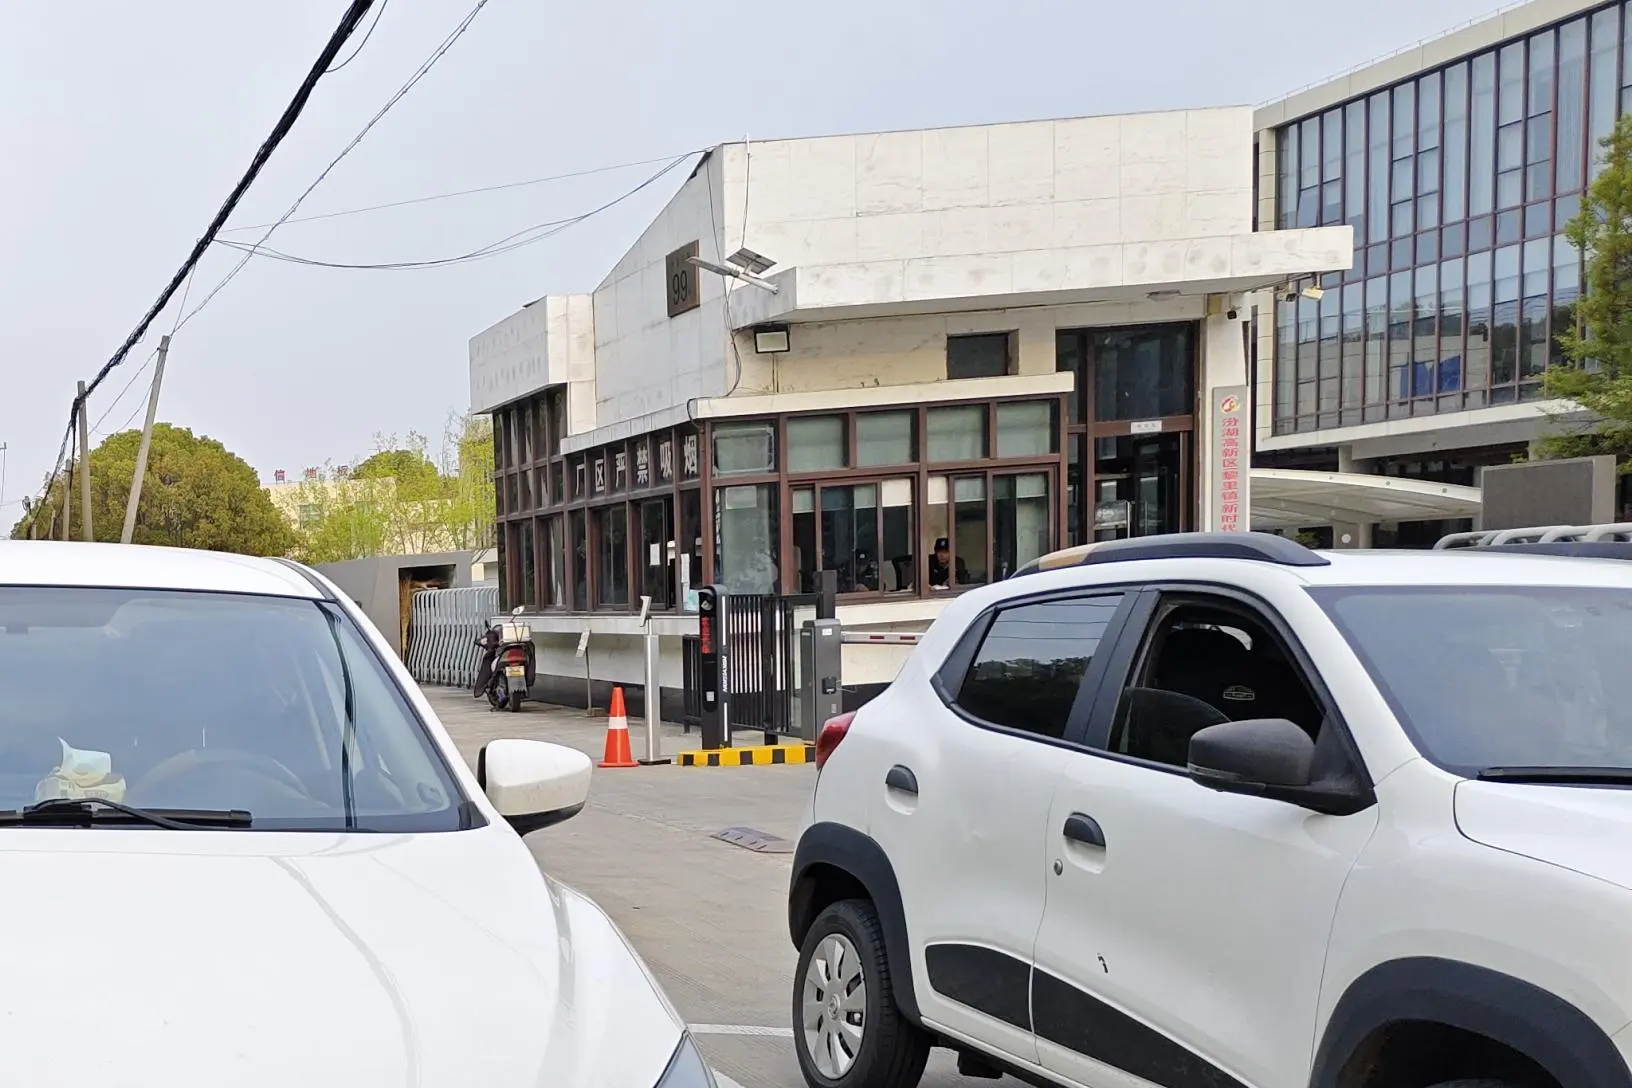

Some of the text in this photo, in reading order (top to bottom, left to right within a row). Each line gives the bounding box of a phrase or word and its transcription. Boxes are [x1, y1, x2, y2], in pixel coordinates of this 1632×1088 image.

[672, 270, 688, 306] 99
[575, 434, 699, 497] 厂区严禁吸烟
